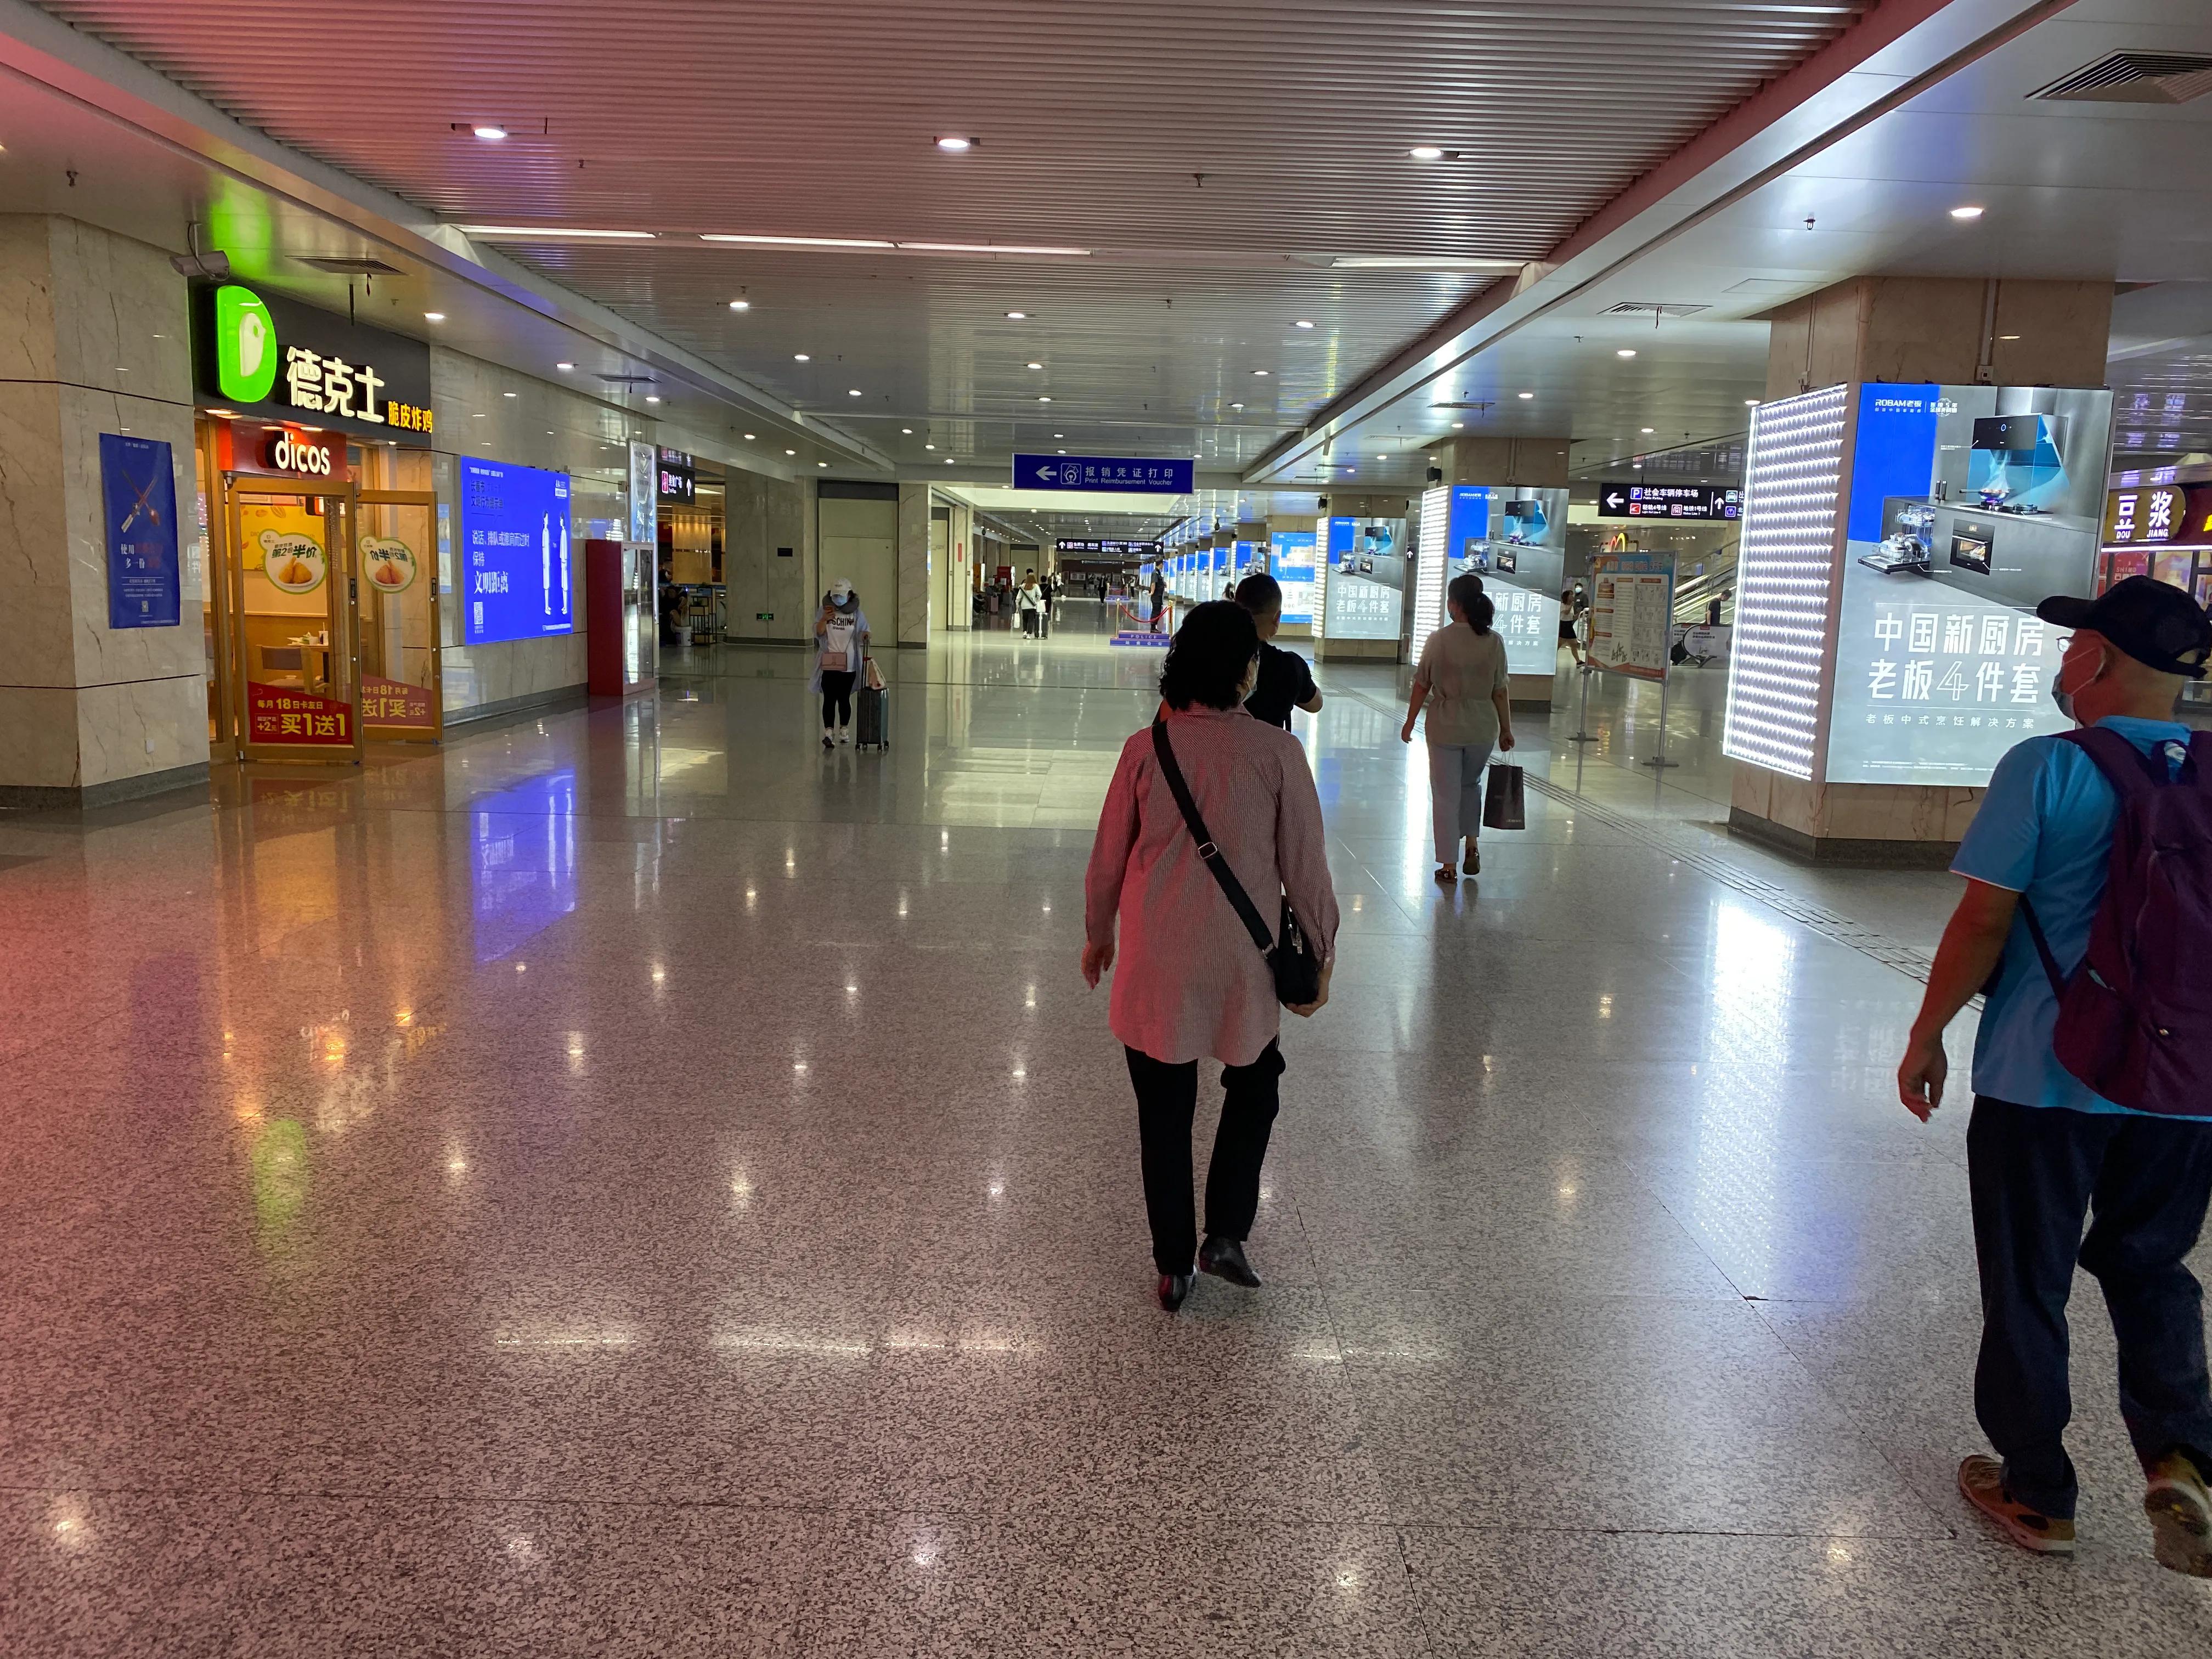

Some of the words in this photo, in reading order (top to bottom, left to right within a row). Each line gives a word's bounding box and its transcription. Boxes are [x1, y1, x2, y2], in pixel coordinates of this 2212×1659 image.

[287, 346, 385, 424] 德克士
[388, 400, 433, 433] 脆皮炸鸡
[275, 431, 330, 475] dicos
[1085, 466, 1173, 479] 报销凭证打印
[1644, 488, 1699, 498] 社会车辆停车场
[2114, 491, 2173, 530] 豆浆
[2116, 531, 2130, 539] DOU
[2146, 529, 2169, 538] JIANG
[473, 551, 485, 567] 保持
[474, 571, 509, 594] 文明距离
[1338, 585, 1390, 599] 中国新厨房
[1336, 599, 1390, 613] 老板4件套
[1483, 592, 1542, 612] 新厨房
[826, 617, 855, 626] SCHIN
[1874, 612, 2045, 656] 中国新厨房
[1867, 659, 2041, 703] 老板4件套
[281, 713, 345, 736] 买1送1
[1866, 714, 2034, 729] 老板中式烹饪解决方案
